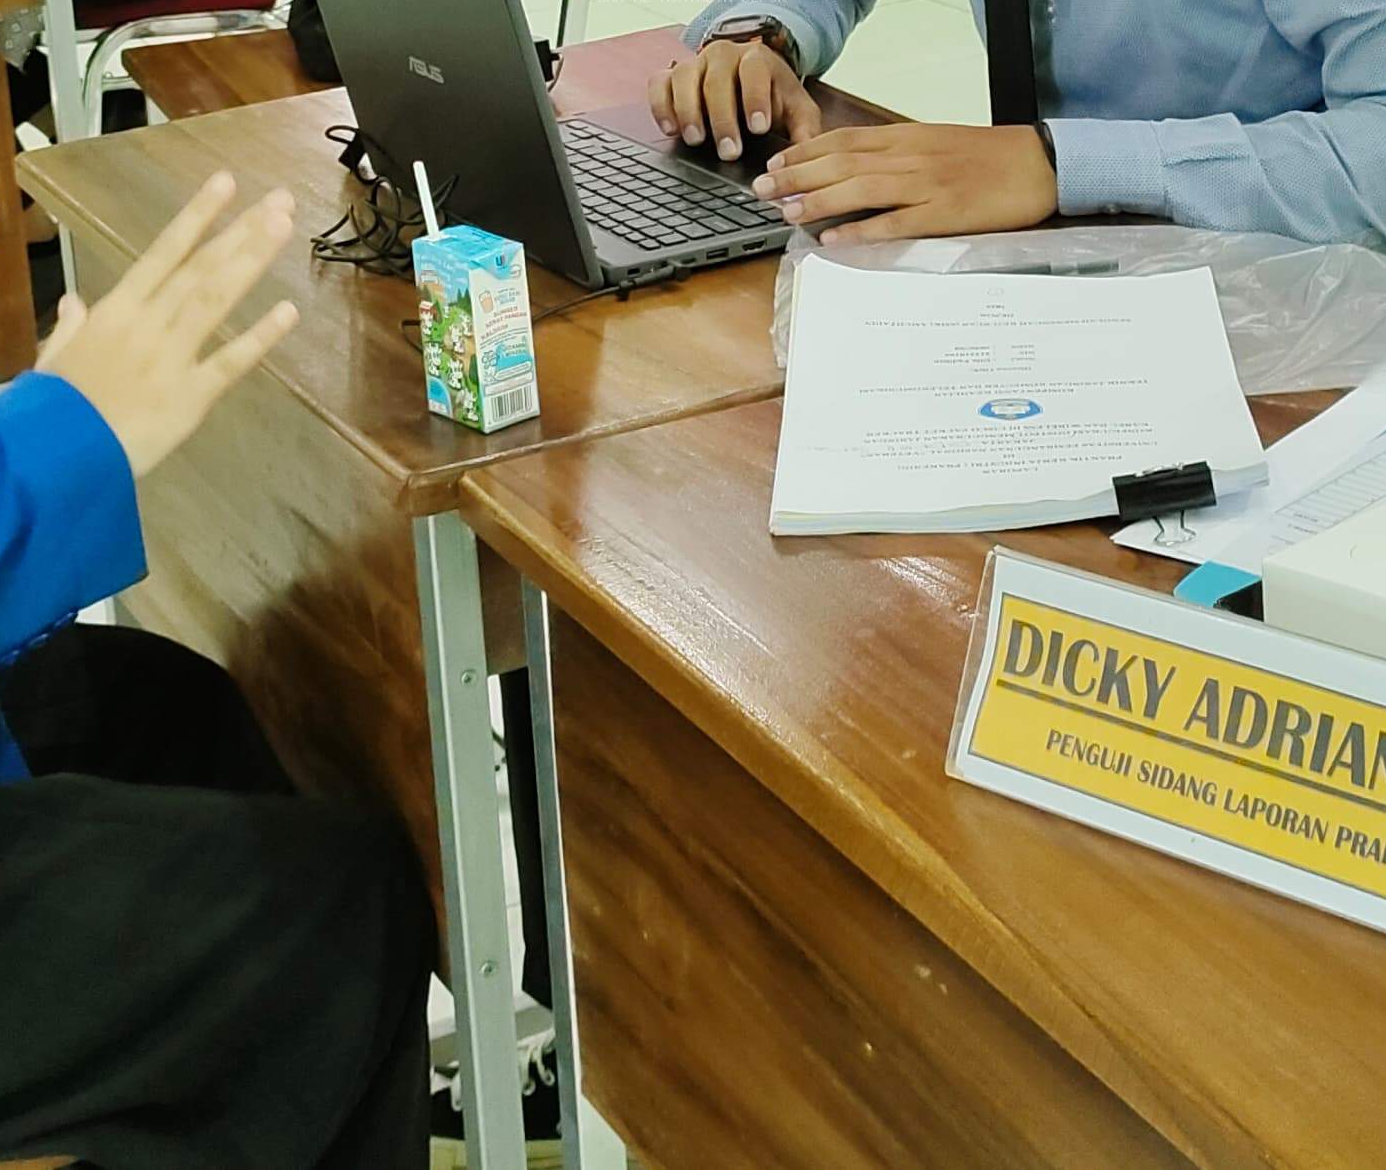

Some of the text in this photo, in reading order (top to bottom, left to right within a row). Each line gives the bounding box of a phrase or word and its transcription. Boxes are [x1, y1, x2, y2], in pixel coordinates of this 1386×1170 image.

[408, 55, 444, 84] ASUS
[1003, 618, 1177, 722] DICKY
[1045, 729, 1133, 778] PENGUJI
[1137, 760, 1218, 807] SIDANG
[1223, 787, 1329, 840] LAPORAN
